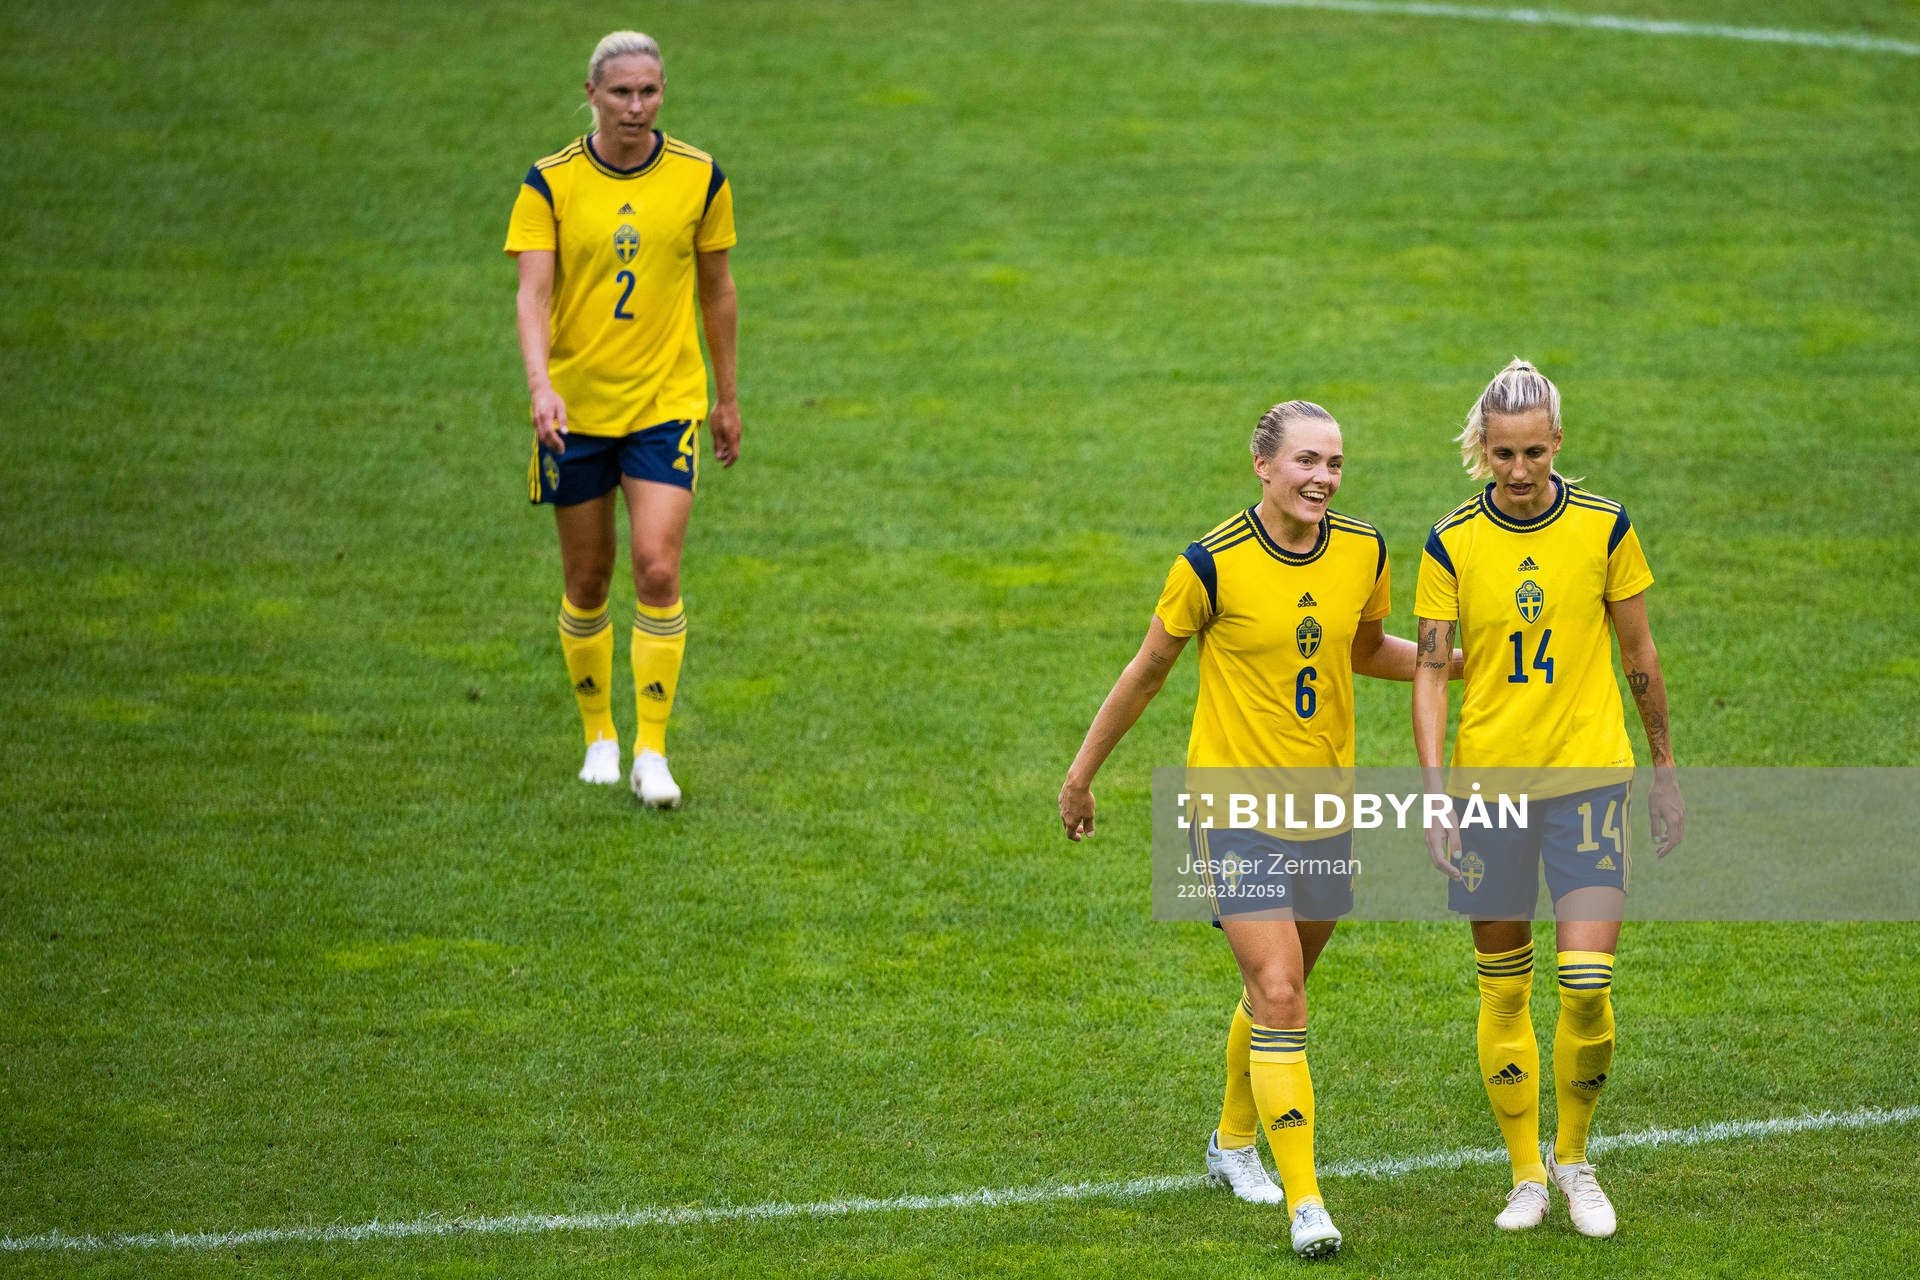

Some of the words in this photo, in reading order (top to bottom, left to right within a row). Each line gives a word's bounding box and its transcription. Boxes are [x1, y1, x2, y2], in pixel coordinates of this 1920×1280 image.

[614, 271, 636, 320] 2
[1507, 629, 1554, 684] 14
[1295, 666, 1318, 719] 6
[1576, 800, 1623, 853] 14
[1488, 1073, 1528, 1086] adidas
[1270, 1119, 1308, 1131] adidas
